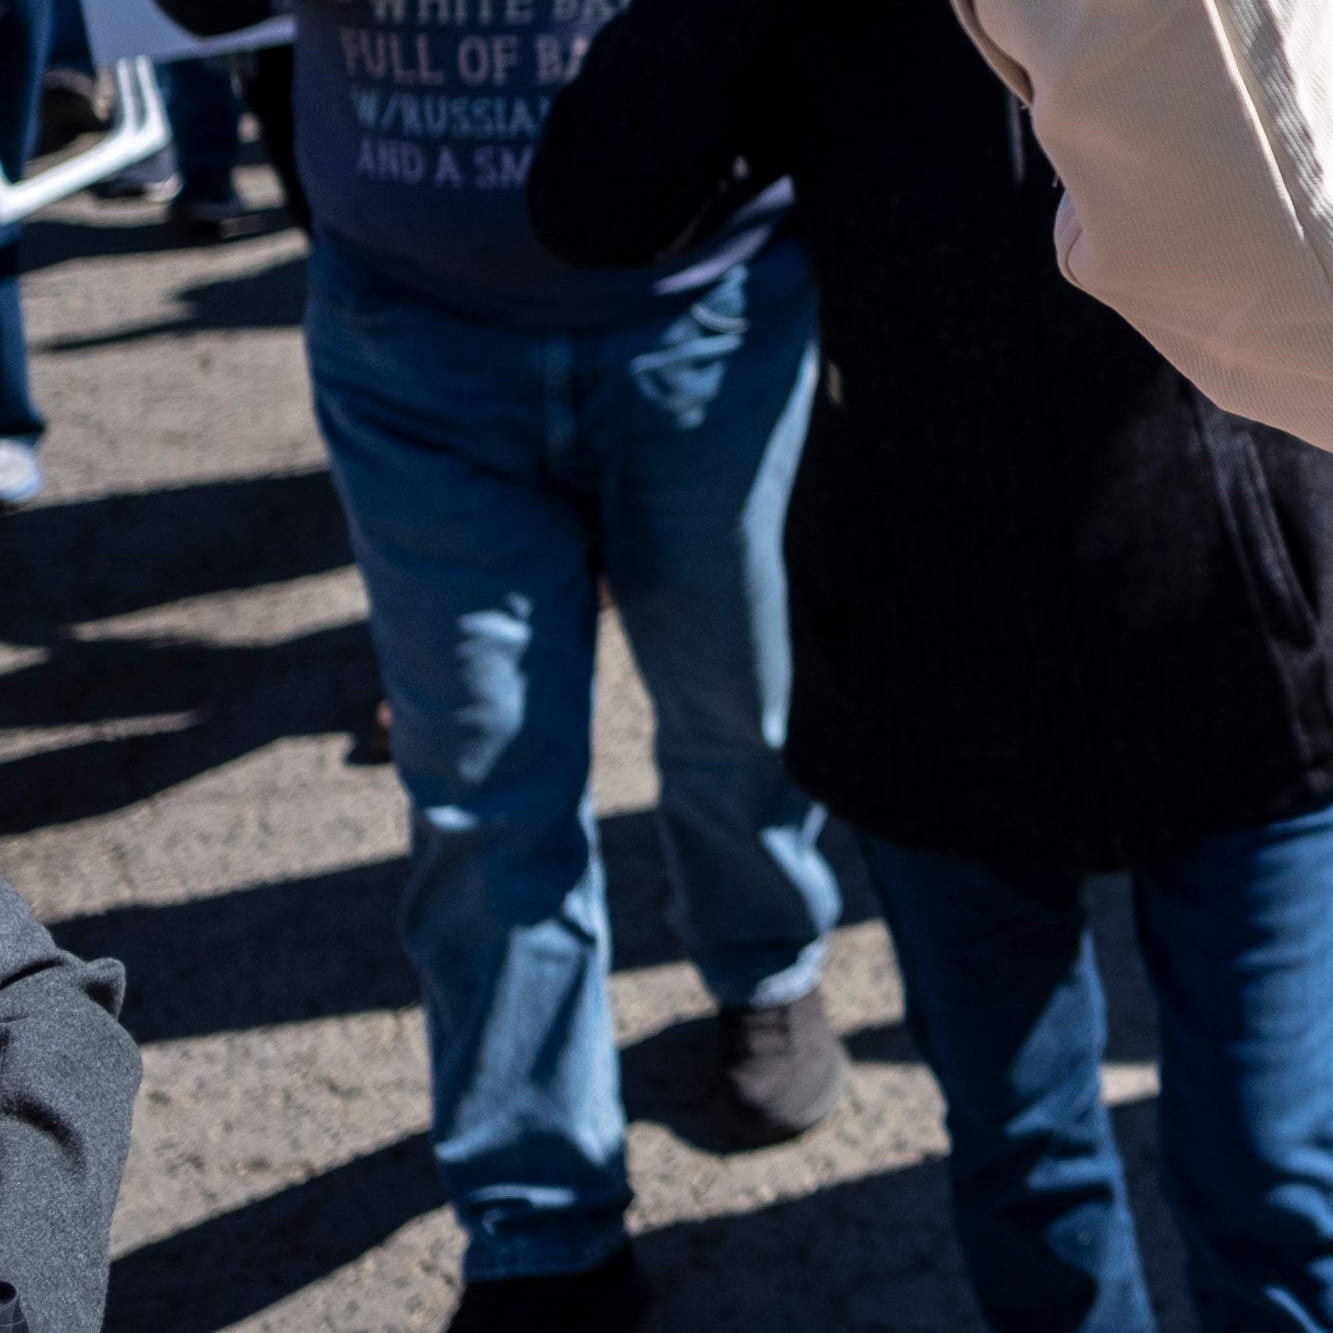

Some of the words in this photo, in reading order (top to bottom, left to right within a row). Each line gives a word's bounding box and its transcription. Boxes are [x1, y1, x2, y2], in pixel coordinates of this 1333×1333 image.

[337, 27, 446, 86] FULL
[457, 34, 520, 87] OF
[436, 145, 463, 189] A
